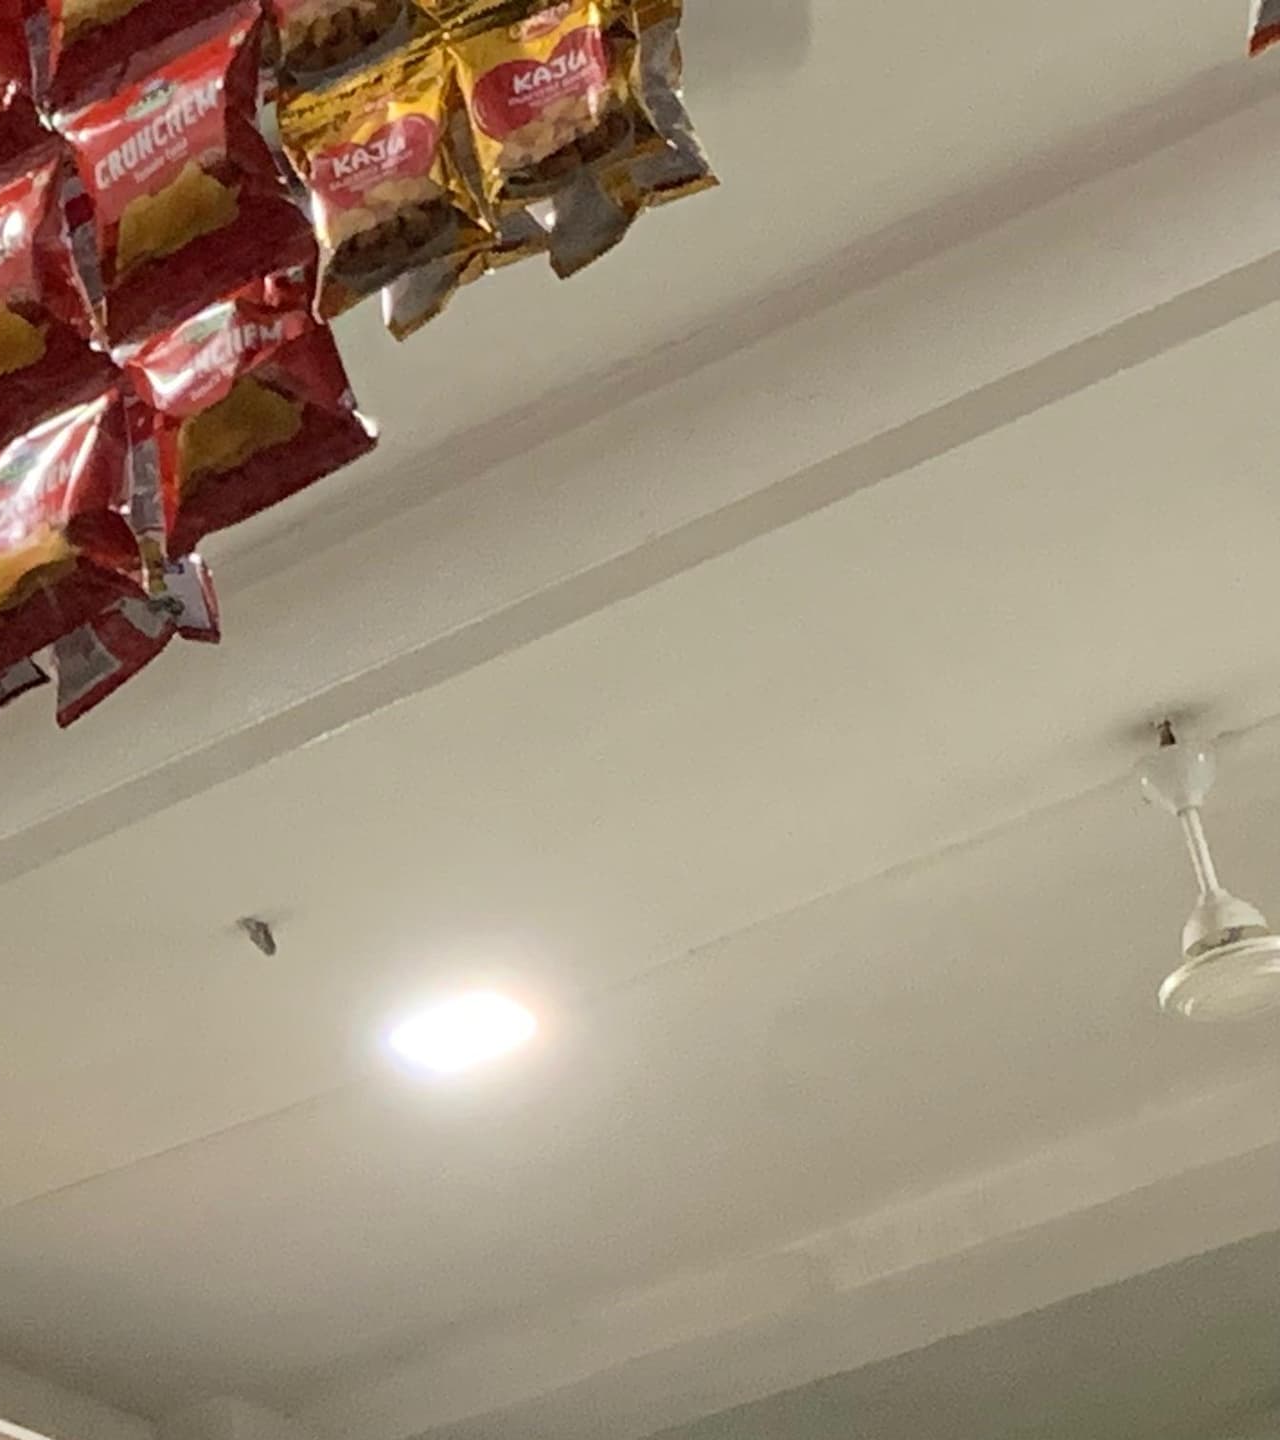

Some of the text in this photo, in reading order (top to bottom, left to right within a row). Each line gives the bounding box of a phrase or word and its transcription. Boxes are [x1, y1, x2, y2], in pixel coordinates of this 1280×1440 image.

[513, 47, 589, 94] KAJU
[94, 83, 220, 190] CRUNCHEM
[333, 136, 407, 177] KAJU
